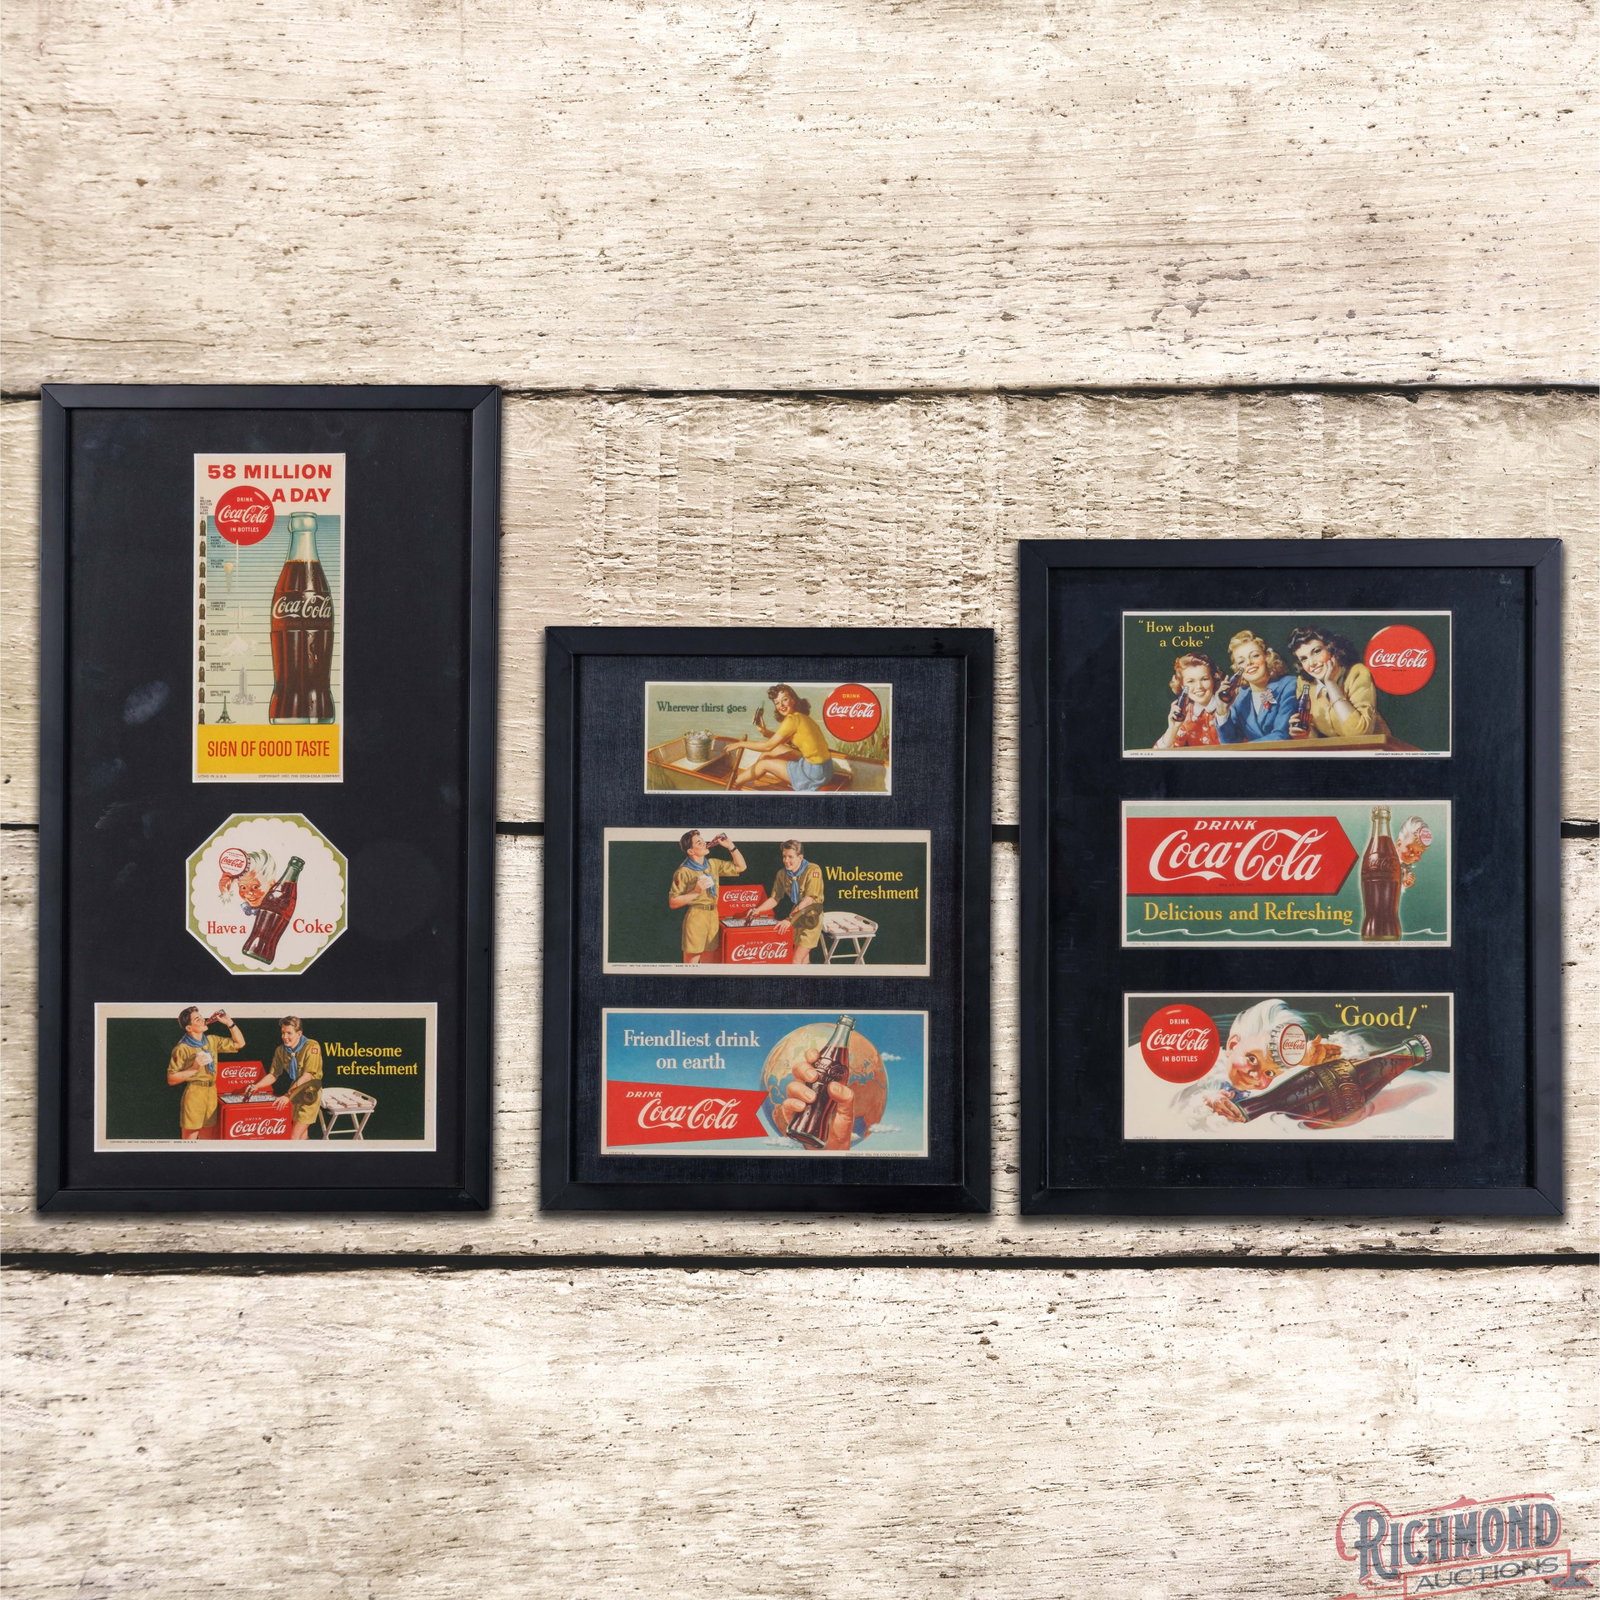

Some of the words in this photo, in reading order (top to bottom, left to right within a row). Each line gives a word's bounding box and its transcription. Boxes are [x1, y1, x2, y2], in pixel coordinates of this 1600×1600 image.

[208, 464, 236, 479] 58
[244, 464, 332, 479] MILLION
[272, 488, 286, 502] A
[290, 488, 332, 502] DAY
[218, 505, 270, 523] Coca-Cola
[272, 594, 332, 618] Coca-Cola
[1179, 622, 1214, 633] about
[1159, 639, 1167, 647] a
[1369, 648, 1430, 668] Coca-Cola
[656, 701, 699, 713] Wherever
[702, 702, 724, 713] thirst
[727, 705, 747, 714] goes
[826, 701, 877, 718] Coca-Cola
[208, 740, 237, 757] SIGN
[241, 740, 256, 757] OF
[259, 740, 292, 757] GOOD
[295, 740, 330, 757] TASTE
[1194, 820, 1258, 830] DRINK
[1149, 828, 1328, 881] Coca-Cola
[825, 866, 903, 881] Wholesome
[838, 885, 919, 900] refreshment
[1144, 902, 1222, 921] Delicious
[1229, 903, 1259, 921] and
[1264, 902, 1353, 926] Refreshing
[207, 921, 237, 934] Have
[240, 926, 246, 934] a
[293, 918, 333, 934] Coke
[732, 941, 789, 962] Coca-Cola
[624, 1030, 711, 1047] Friendliest
[715, 1030, 760, 1047] drink
[1146, 1028, 1212, 1050] Coca-Cola
[324, 1042, 402, 1058] Wholesome
[656, 1055, 677, 1069] on
[682, 1052, 726, 1069] earth
[1162, 1055, 1170, 1063] IN
[1171, 1055, 1198, 1063] BOTTLES
[336, 1061, 418, 1075] refreshment
[638, 1098, 742, 1129] Coca-Cola
[230, 1117, 286, 1138] Coca-Cola
